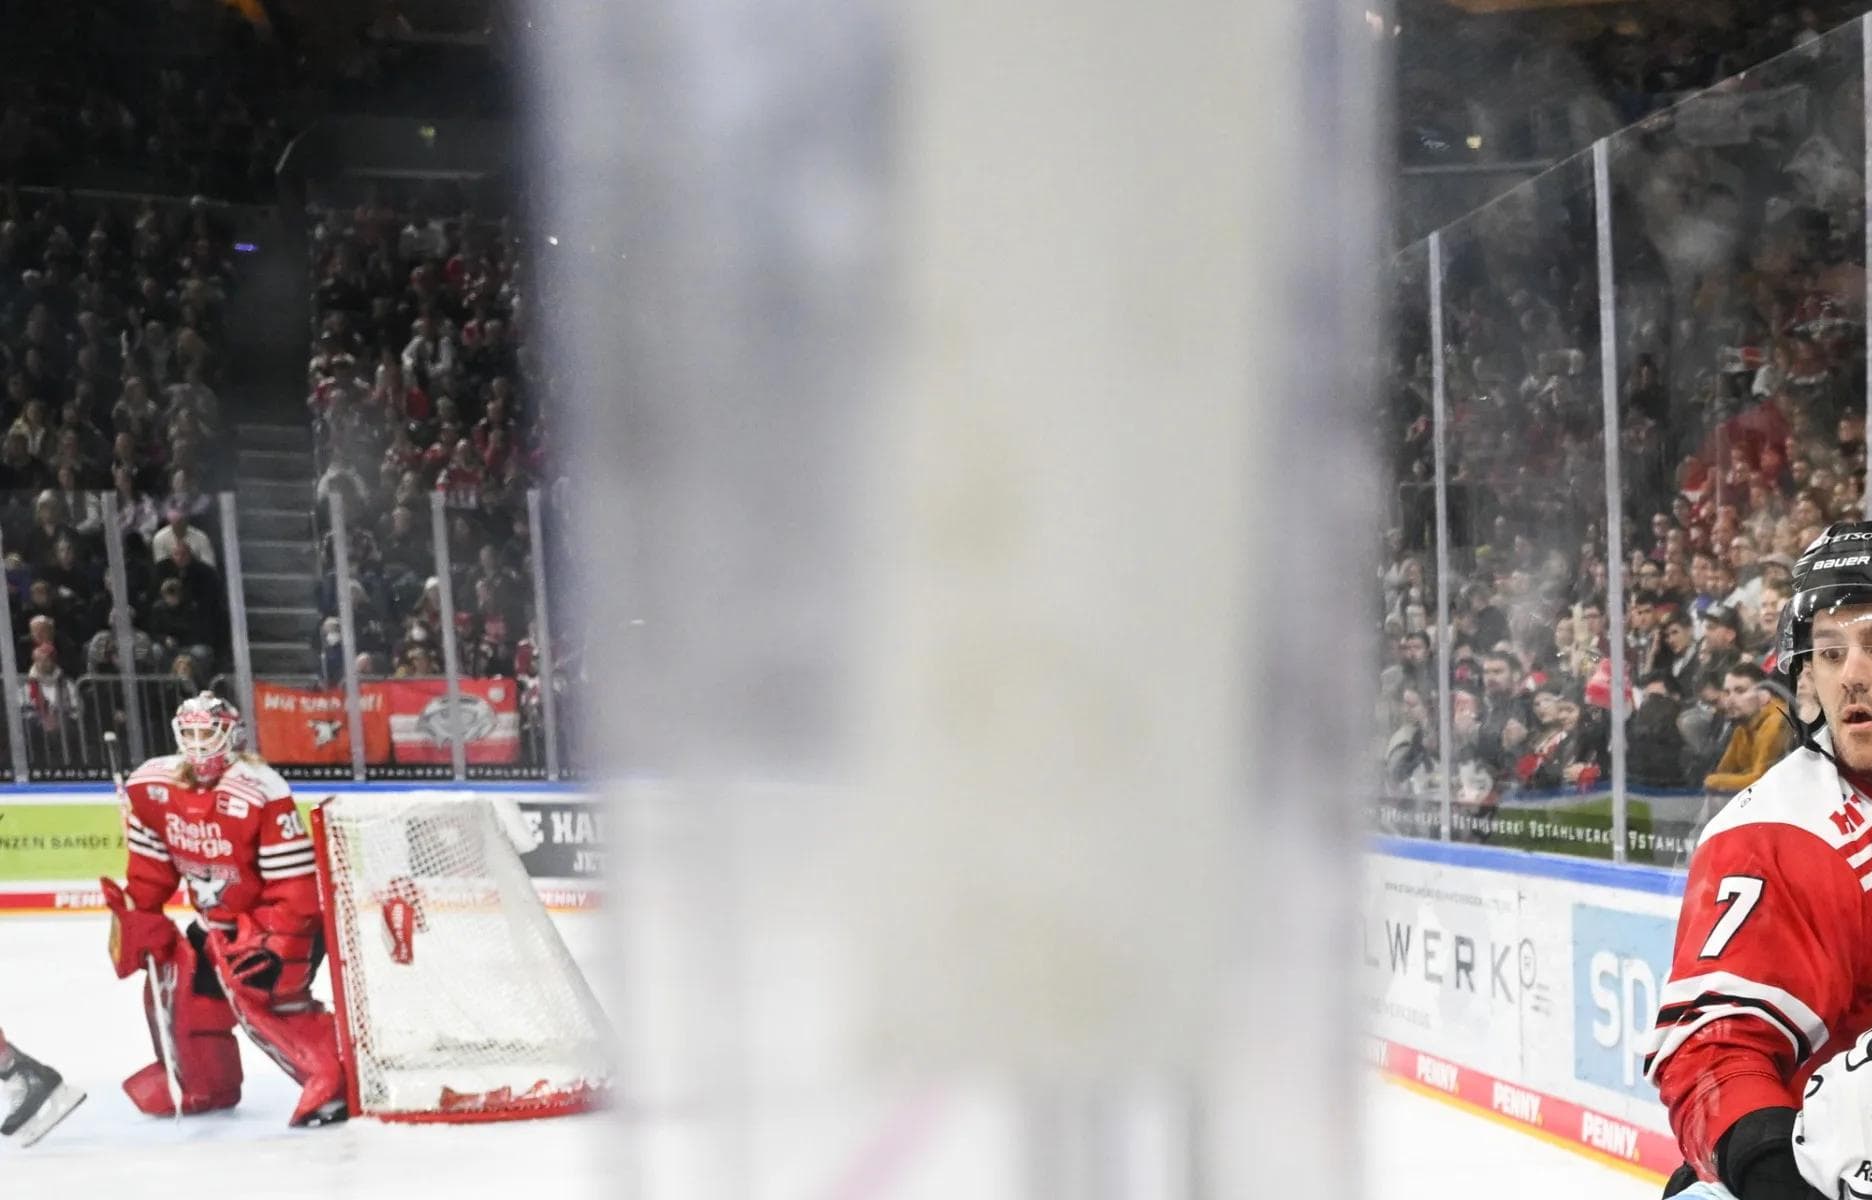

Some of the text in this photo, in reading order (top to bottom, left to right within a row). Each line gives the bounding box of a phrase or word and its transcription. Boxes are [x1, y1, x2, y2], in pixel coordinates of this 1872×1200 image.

[1812, 555, 1871, 571] BAUER
[1638, 836, 1698, 852] STAHLW
[1699, 876, 1765, 960] 7
